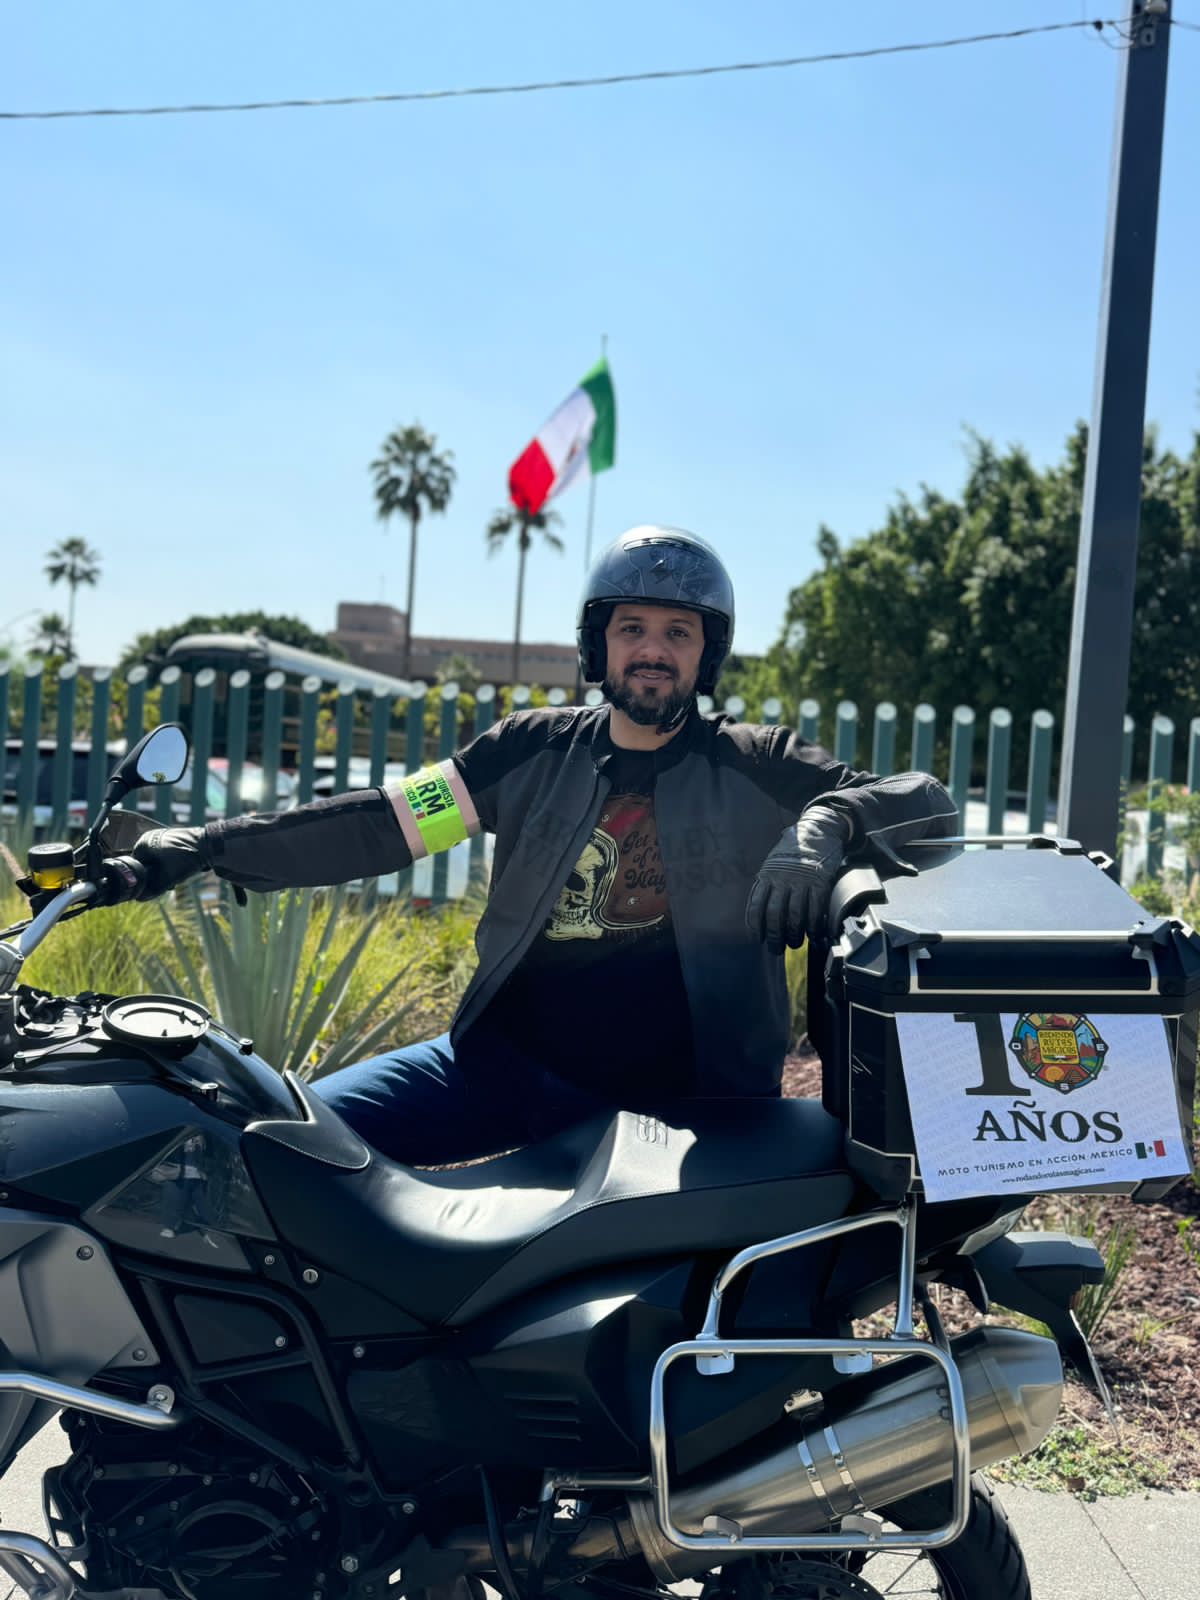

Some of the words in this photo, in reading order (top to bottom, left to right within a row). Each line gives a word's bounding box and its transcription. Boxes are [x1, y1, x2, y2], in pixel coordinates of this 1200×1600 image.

[621, 831, 648, 855] Get
[633, 846, 653, 869] of
[624, 868, 666, 895] Way
[972, 1100, 1123, 1143] AÑOS
[938, 1167, 970, 1176] MOTO
[974, 1160, 1024, 1173] TURISMO
[1028, 1159, 1042, 1167] EN
[1090, 1148, 1133, 1160] MEXICO
